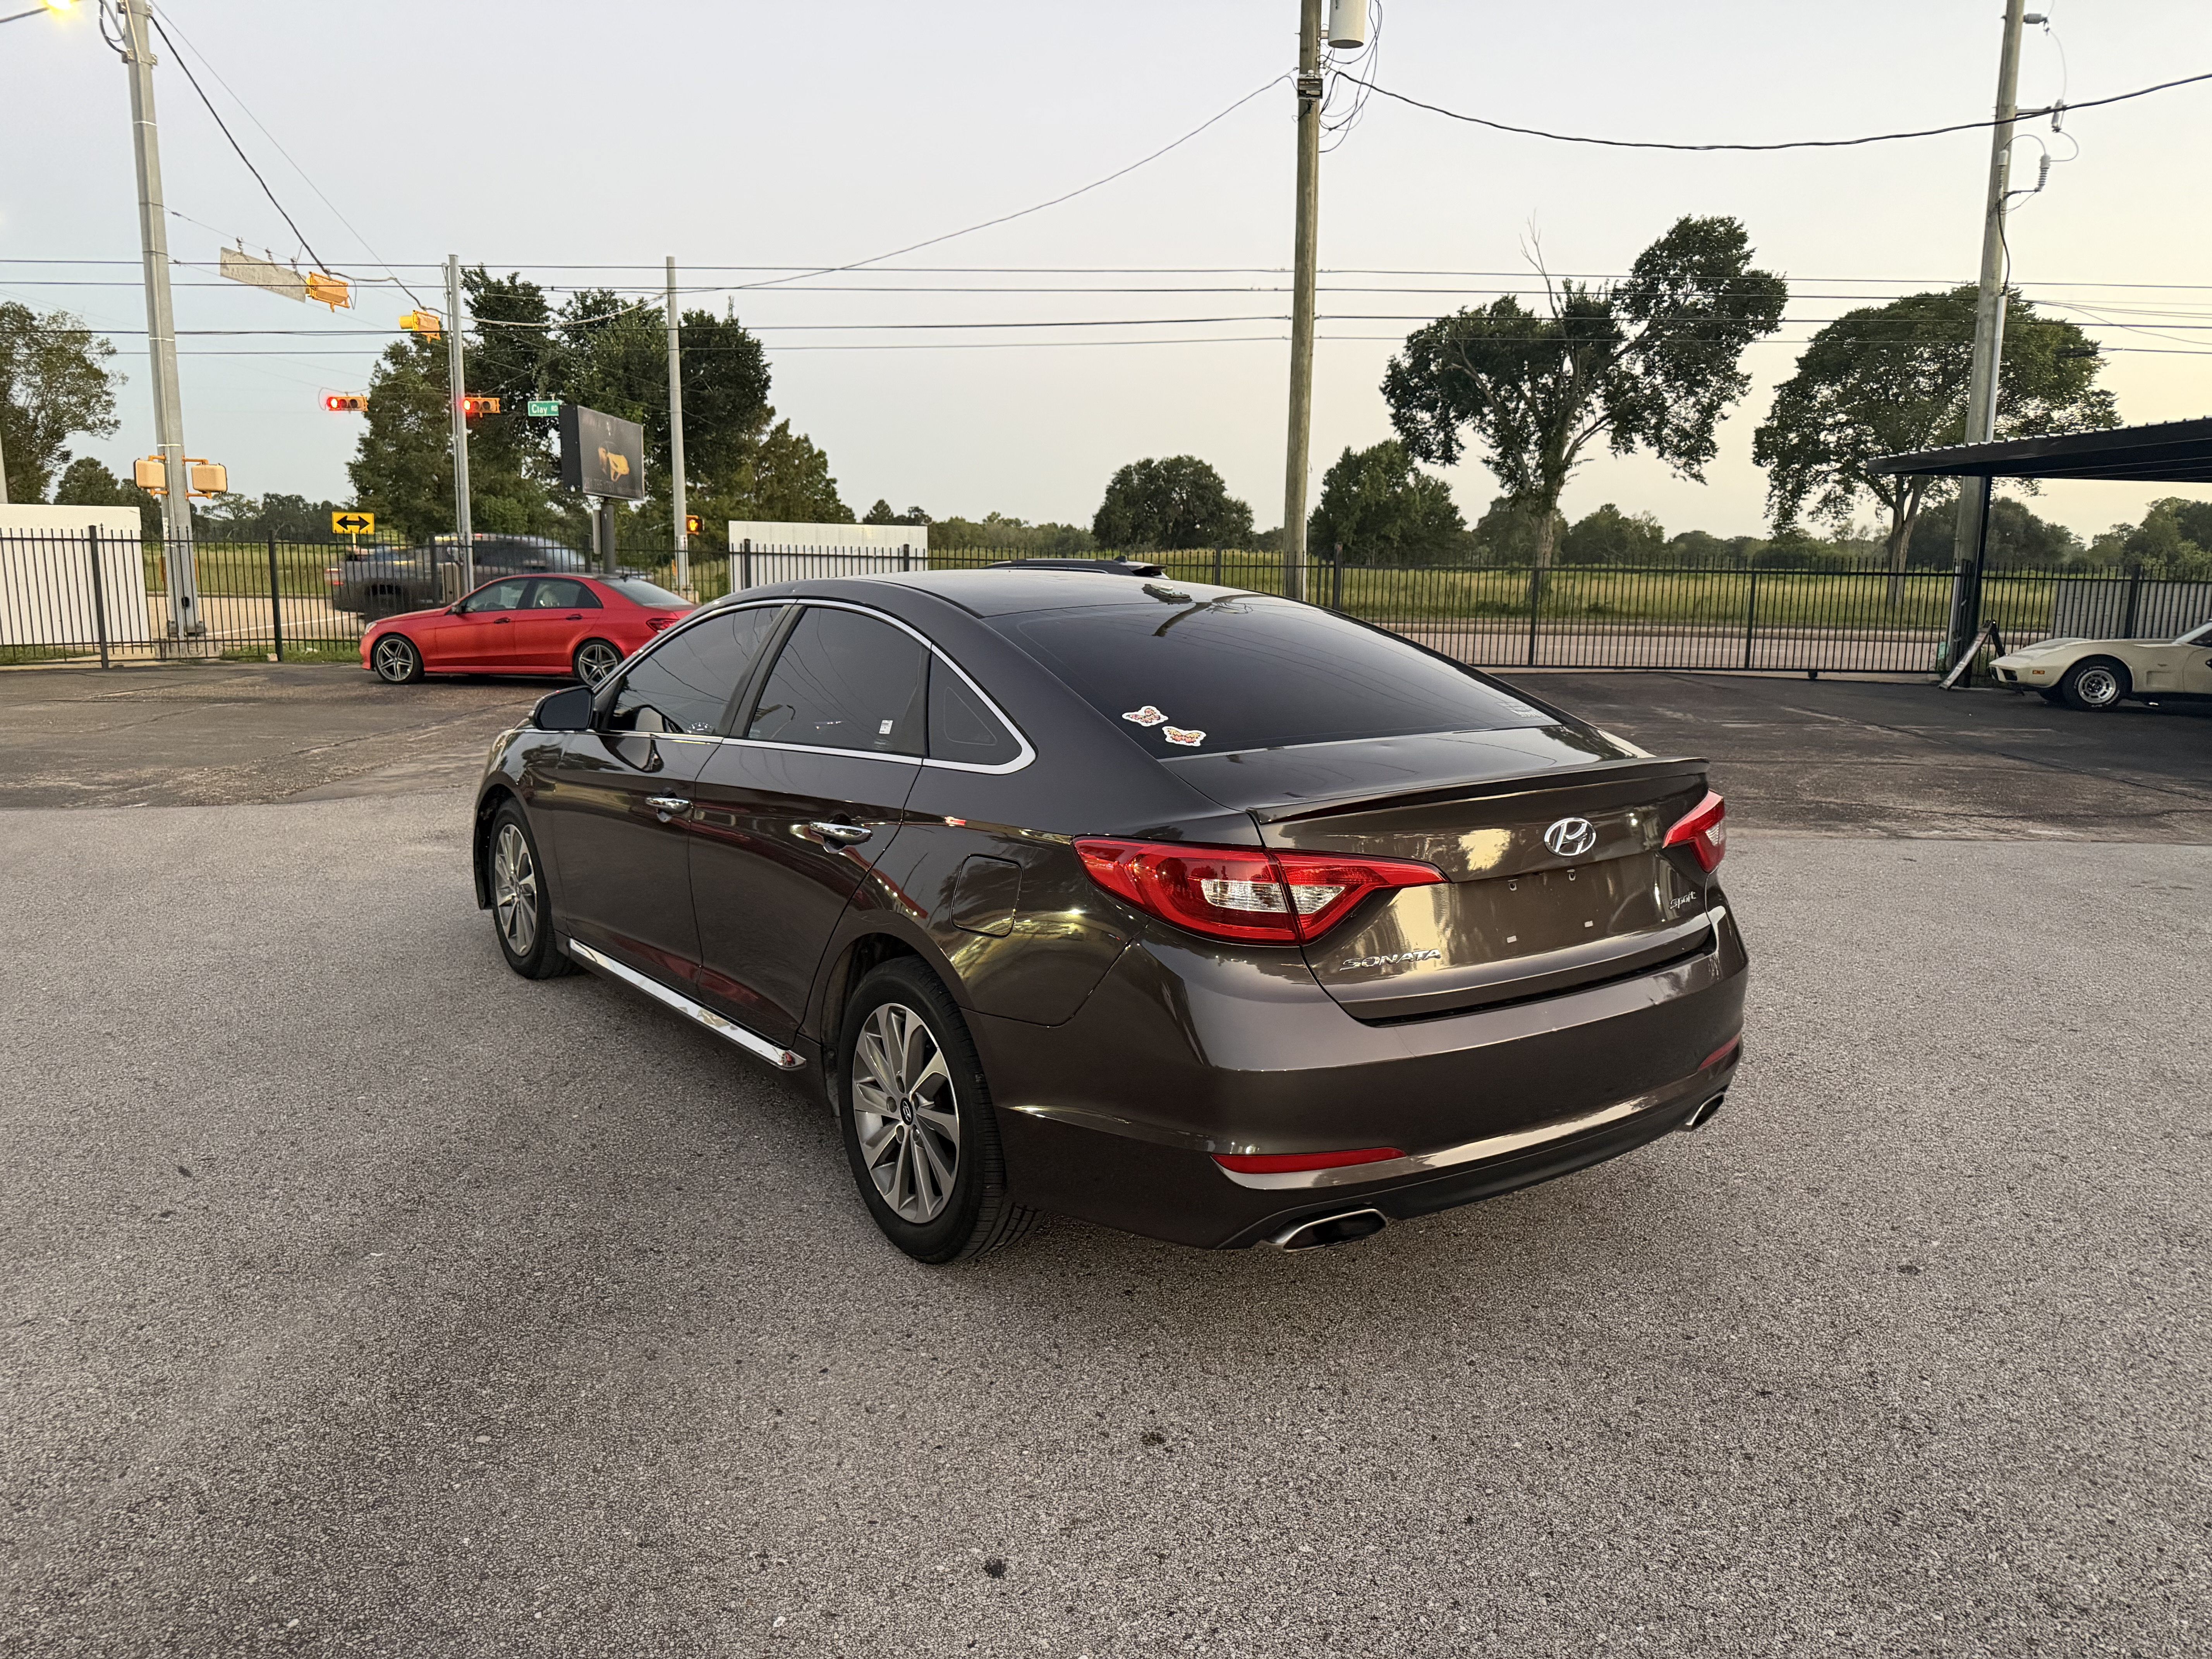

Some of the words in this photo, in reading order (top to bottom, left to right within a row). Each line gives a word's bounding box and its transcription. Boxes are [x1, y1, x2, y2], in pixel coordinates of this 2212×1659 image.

[532, 404, 547, 415] Clay
[1670, 891, 1697, 909] Sport
[1339, 949, 1441, 971] SONATA
